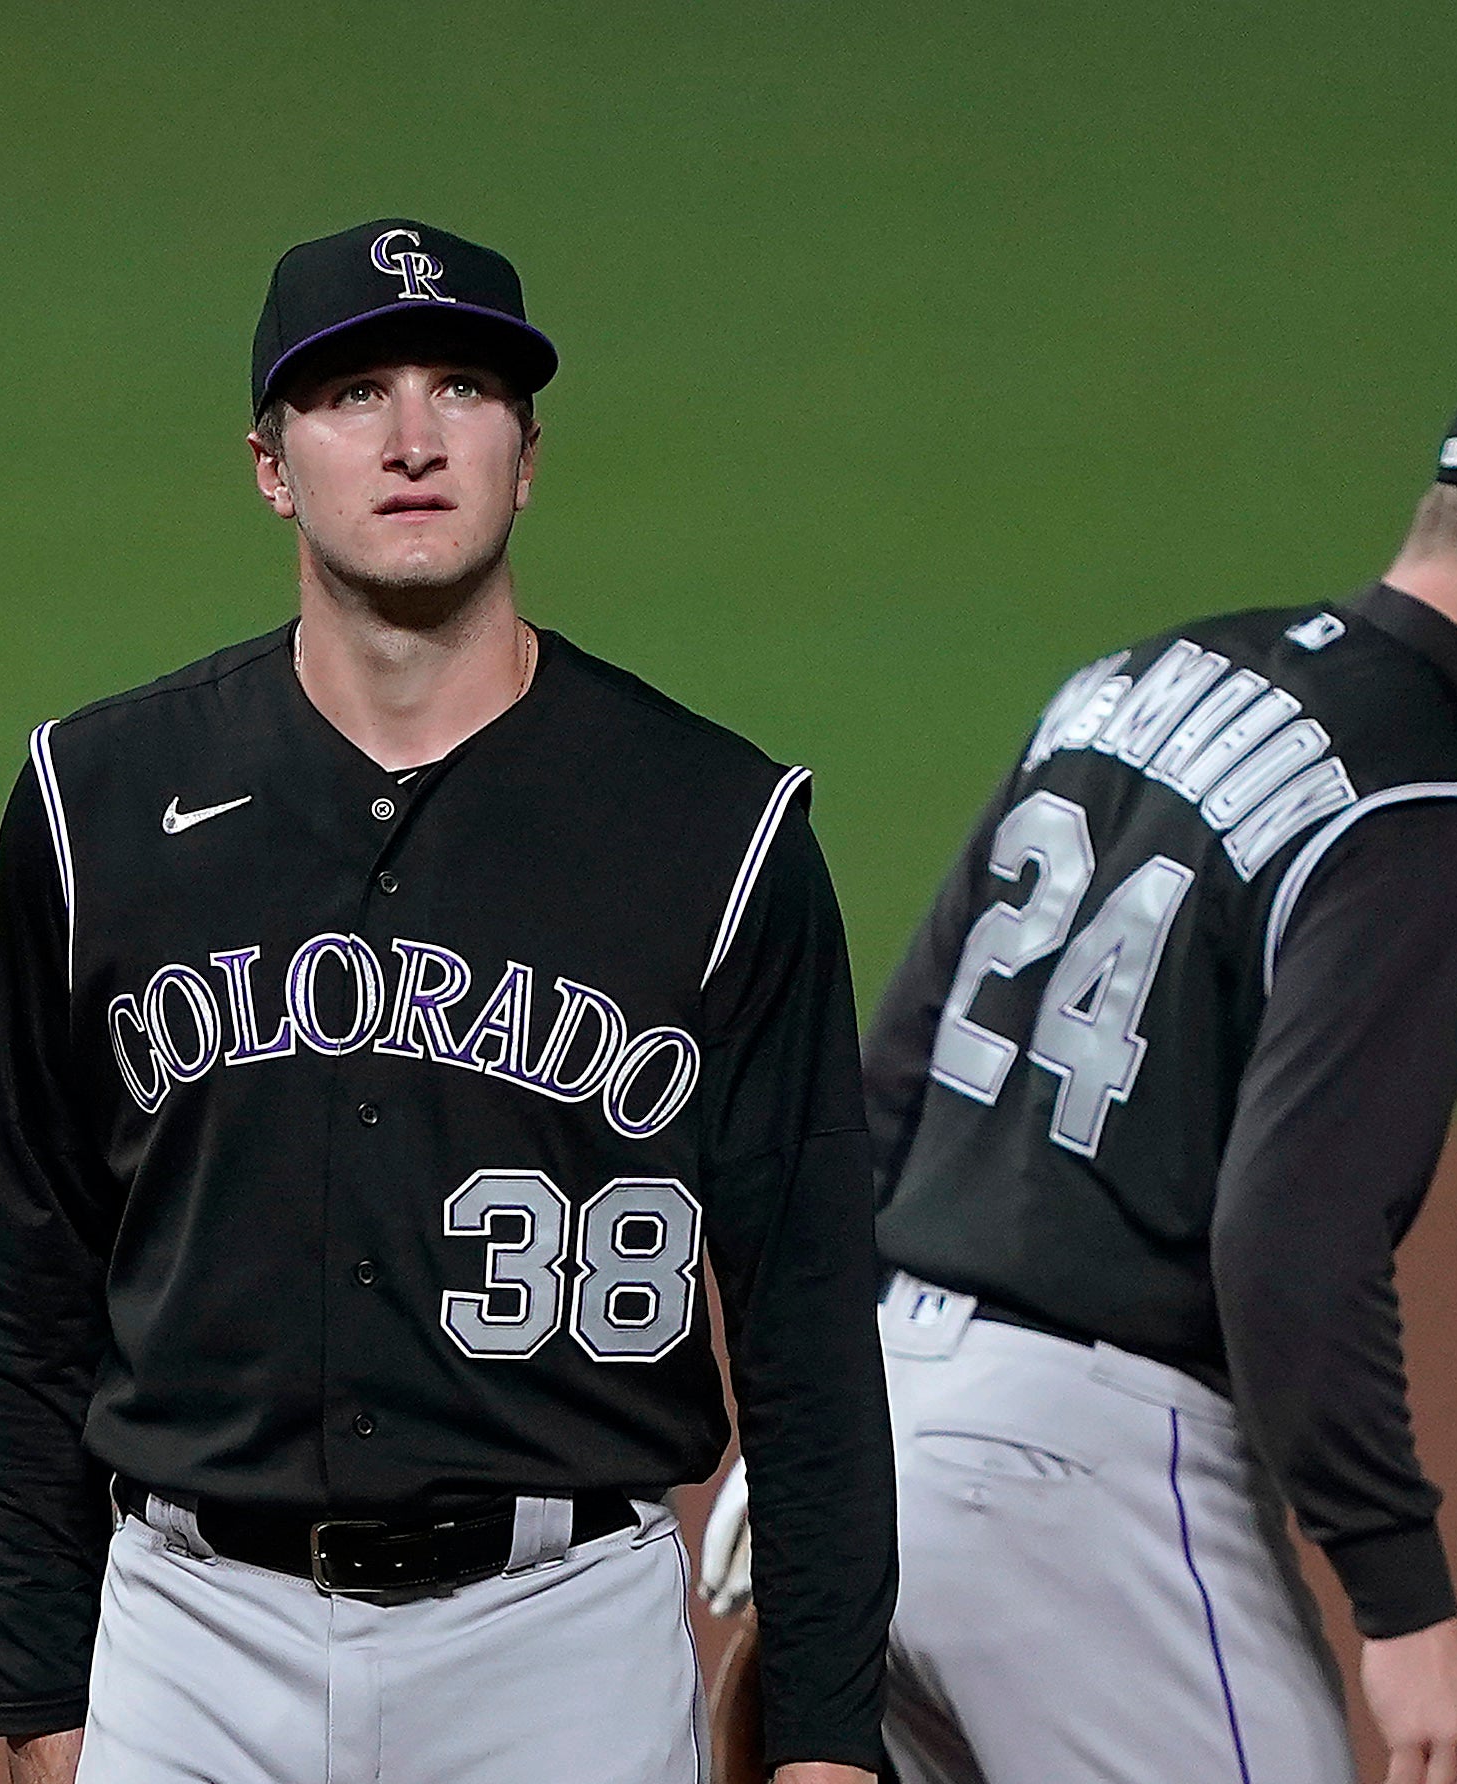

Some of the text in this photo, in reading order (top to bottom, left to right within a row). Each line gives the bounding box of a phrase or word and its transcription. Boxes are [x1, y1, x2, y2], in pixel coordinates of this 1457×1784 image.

[108, 932, 701, 1139] COLORADO
[930, 790, 1195, 1158] 24
[439, 1169, 703, 1363] 38
